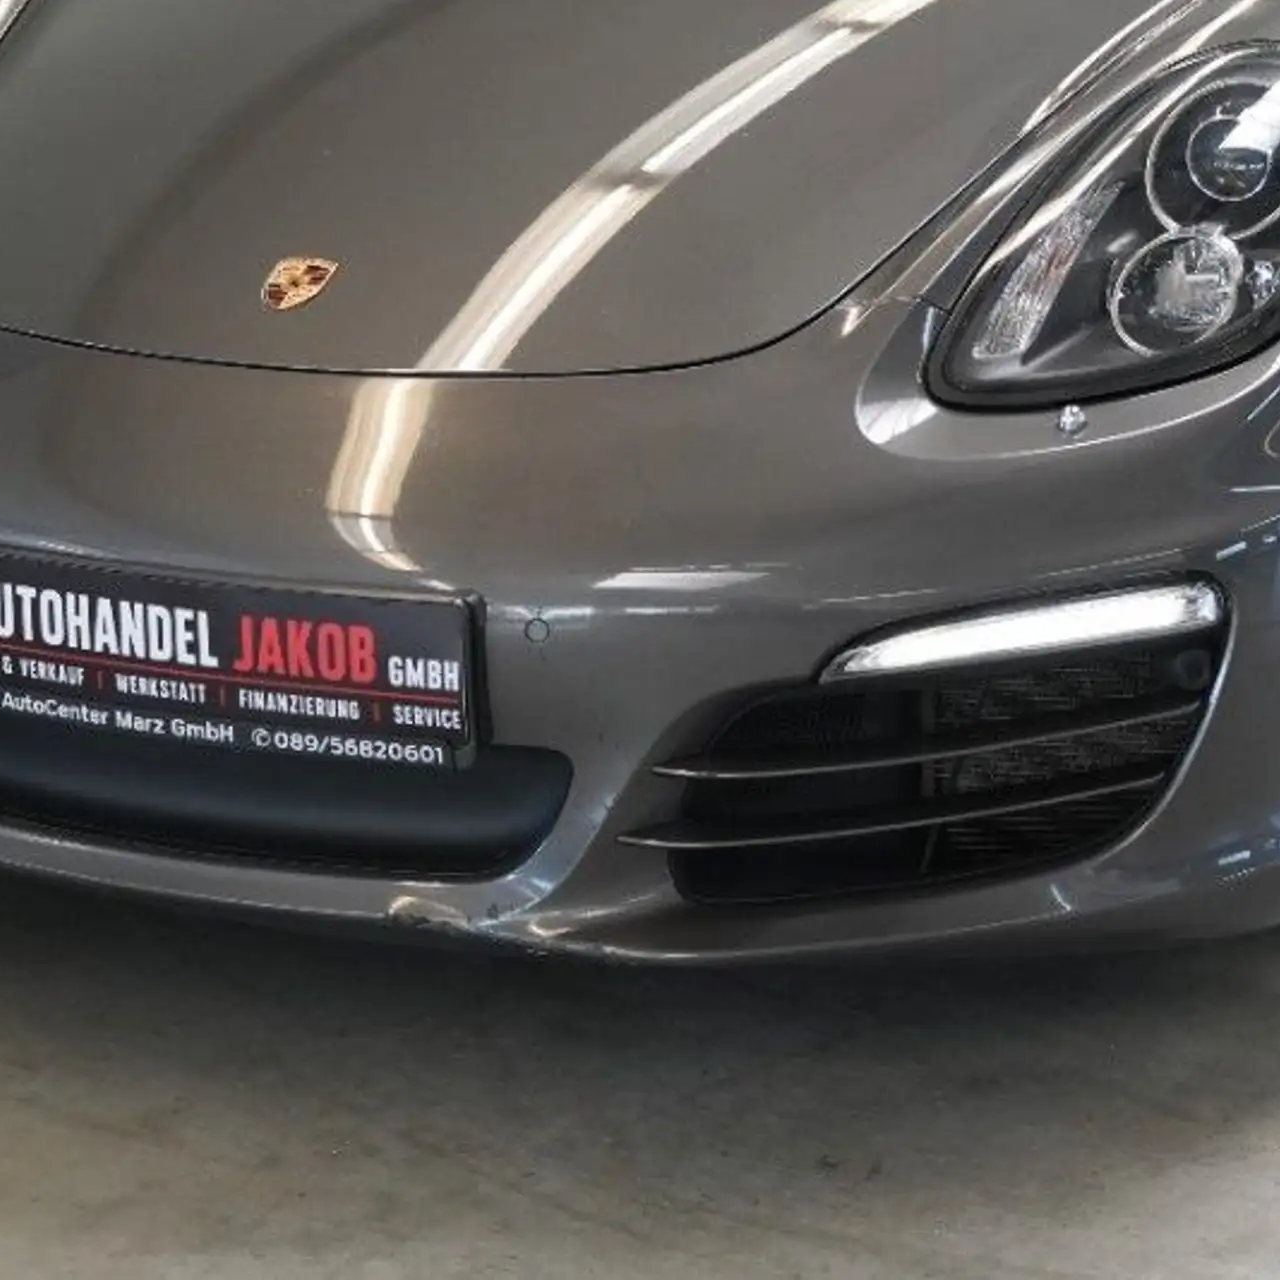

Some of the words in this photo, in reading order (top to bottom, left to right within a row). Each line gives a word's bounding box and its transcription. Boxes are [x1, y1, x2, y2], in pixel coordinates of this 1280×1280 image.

[233, 615, 377, 683] JAKOB
[387, 655, 460, 692] GMBH
[2, 692, 109, 726] AutoCenter
[116, 710, 166, 735] Marz
[171, 718, 234, 744] GmbH
[273, 730, 445, 766] 089/56820601
[22, 659, 84, 687] VERKAUF
[115, 673, 206, 704] WERKSTATT
[239, 688, 361, 721] FINANZIERUNG
[392, 704, 462, 730] SERVICE
